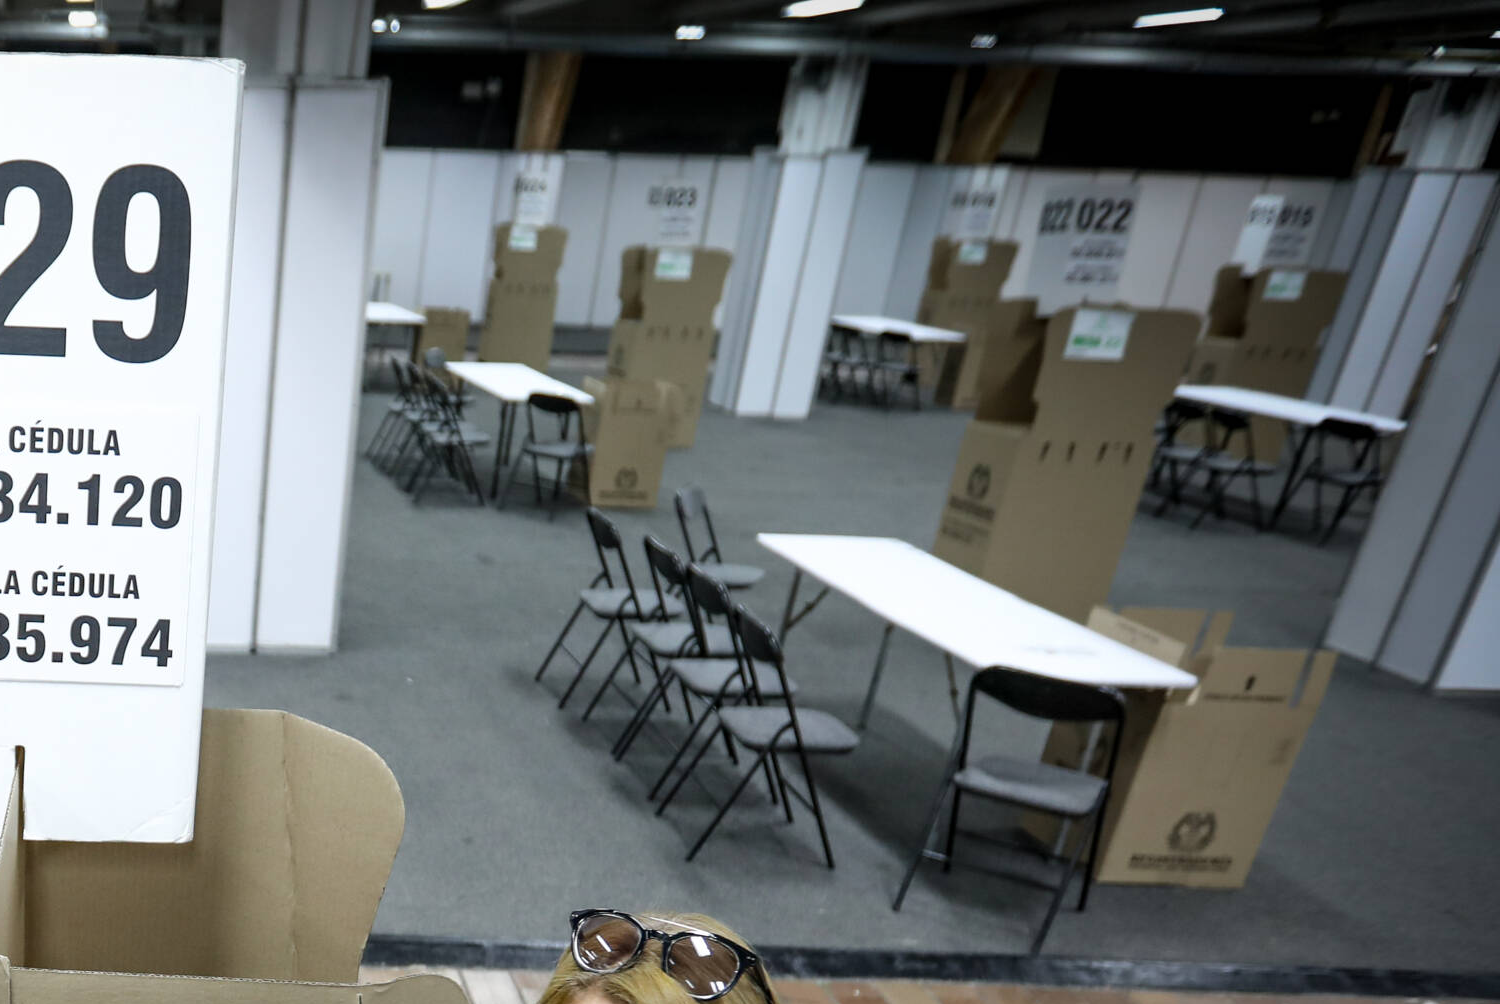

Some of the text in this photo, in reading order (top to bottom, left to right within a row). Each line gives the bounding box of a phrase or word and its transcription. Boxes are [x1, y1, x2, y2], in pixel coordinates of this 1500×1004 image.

[1076, 197, 1136, 236] 022
[8, 419, 121, 457] CÉDULA
[31, 565, 140, 600] CÉDULA
